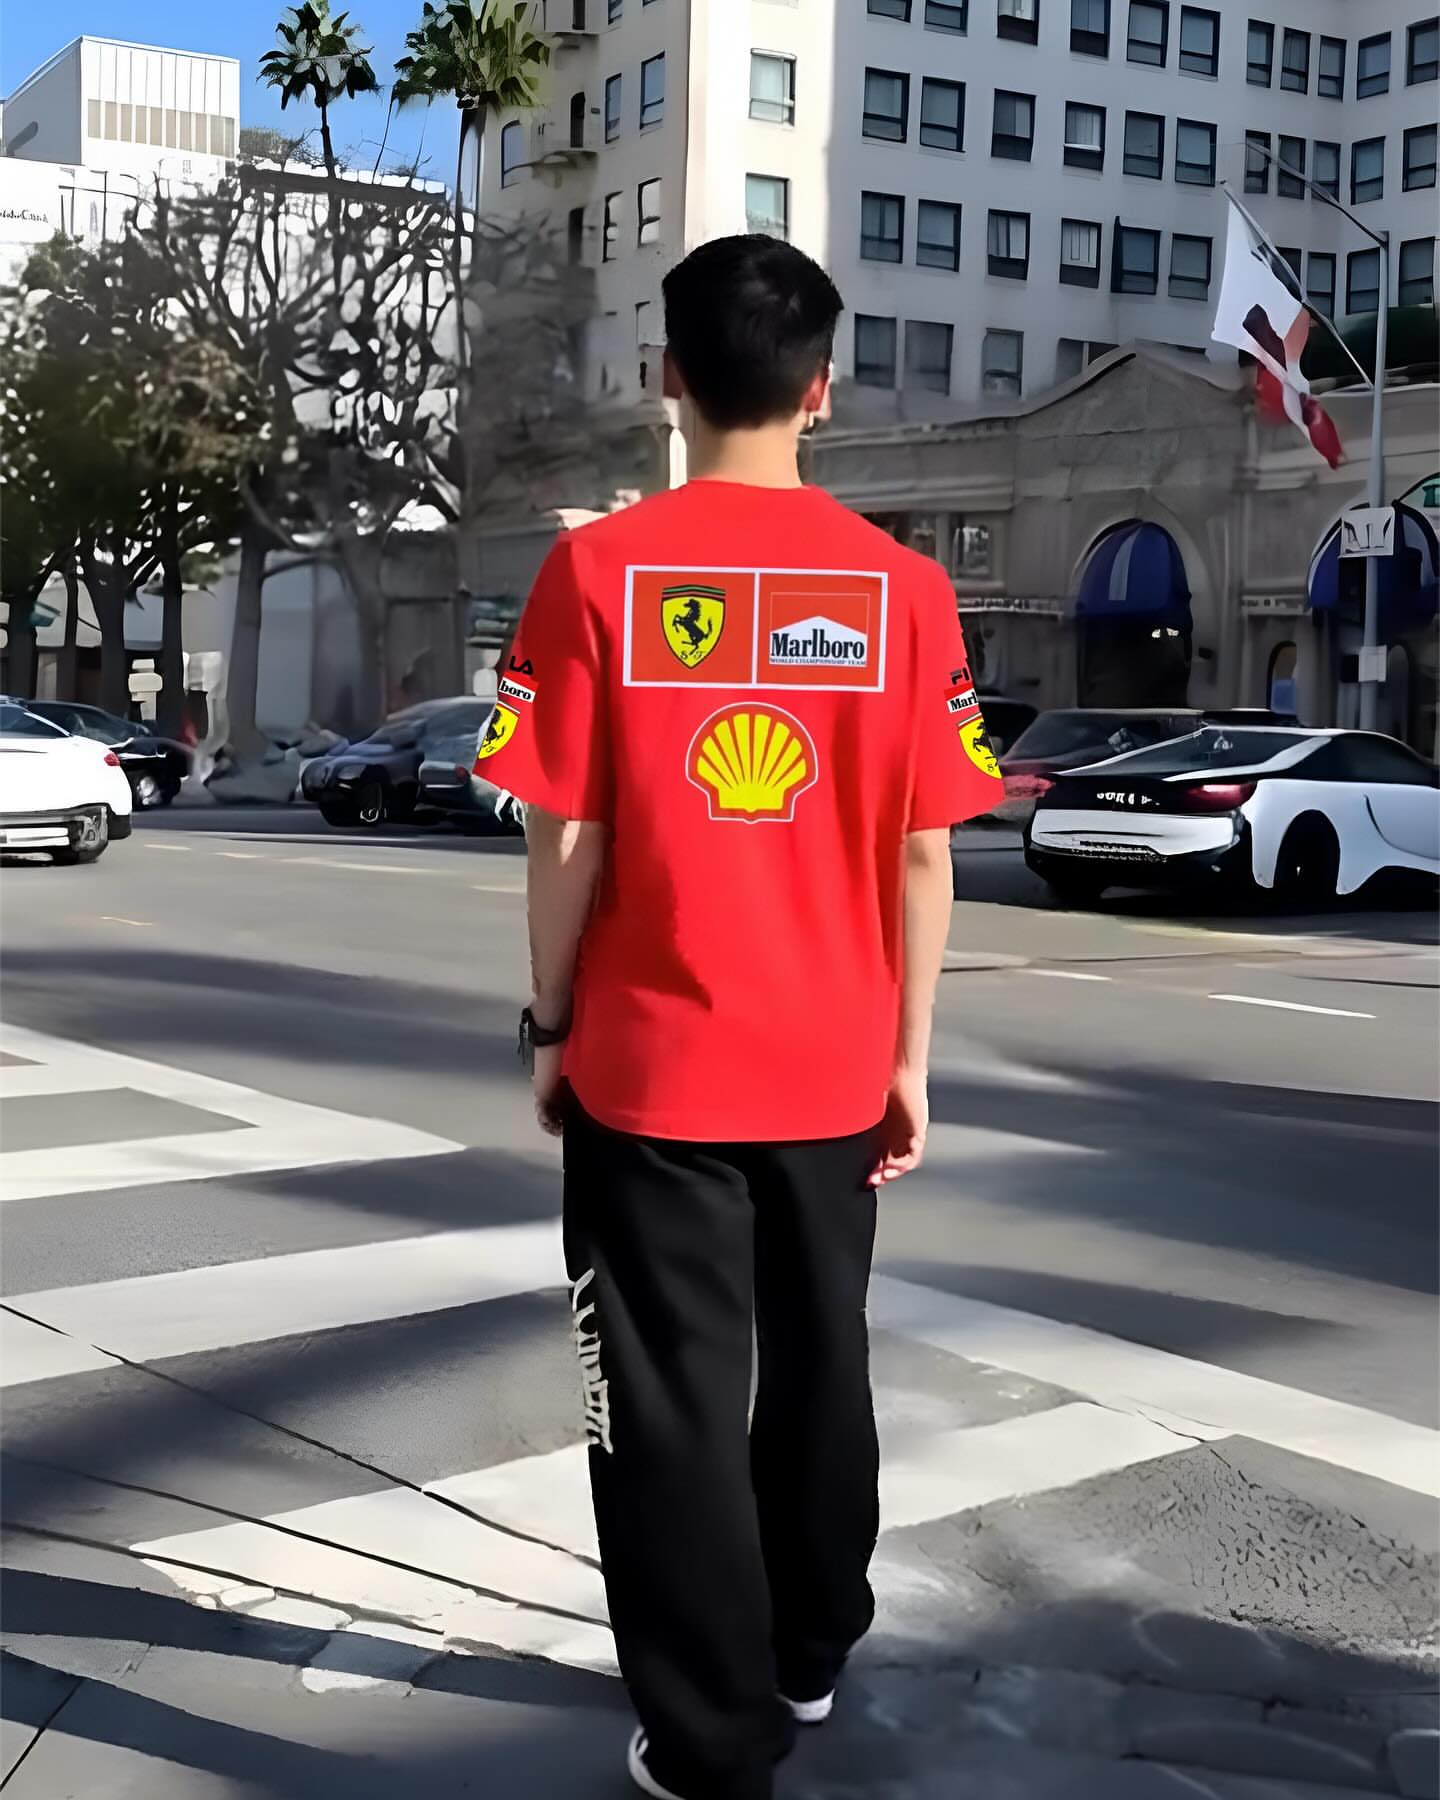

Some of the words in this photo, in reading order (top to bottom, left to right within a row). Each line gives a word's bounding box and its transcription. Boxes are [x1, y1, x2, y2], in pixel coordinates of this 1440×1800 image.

[771, 628, 865, 659] Marlboro
[509, 655, 534, 675] LA
[500, 681, 532, 700] boro
[950, 691, 978, 711] Marl
